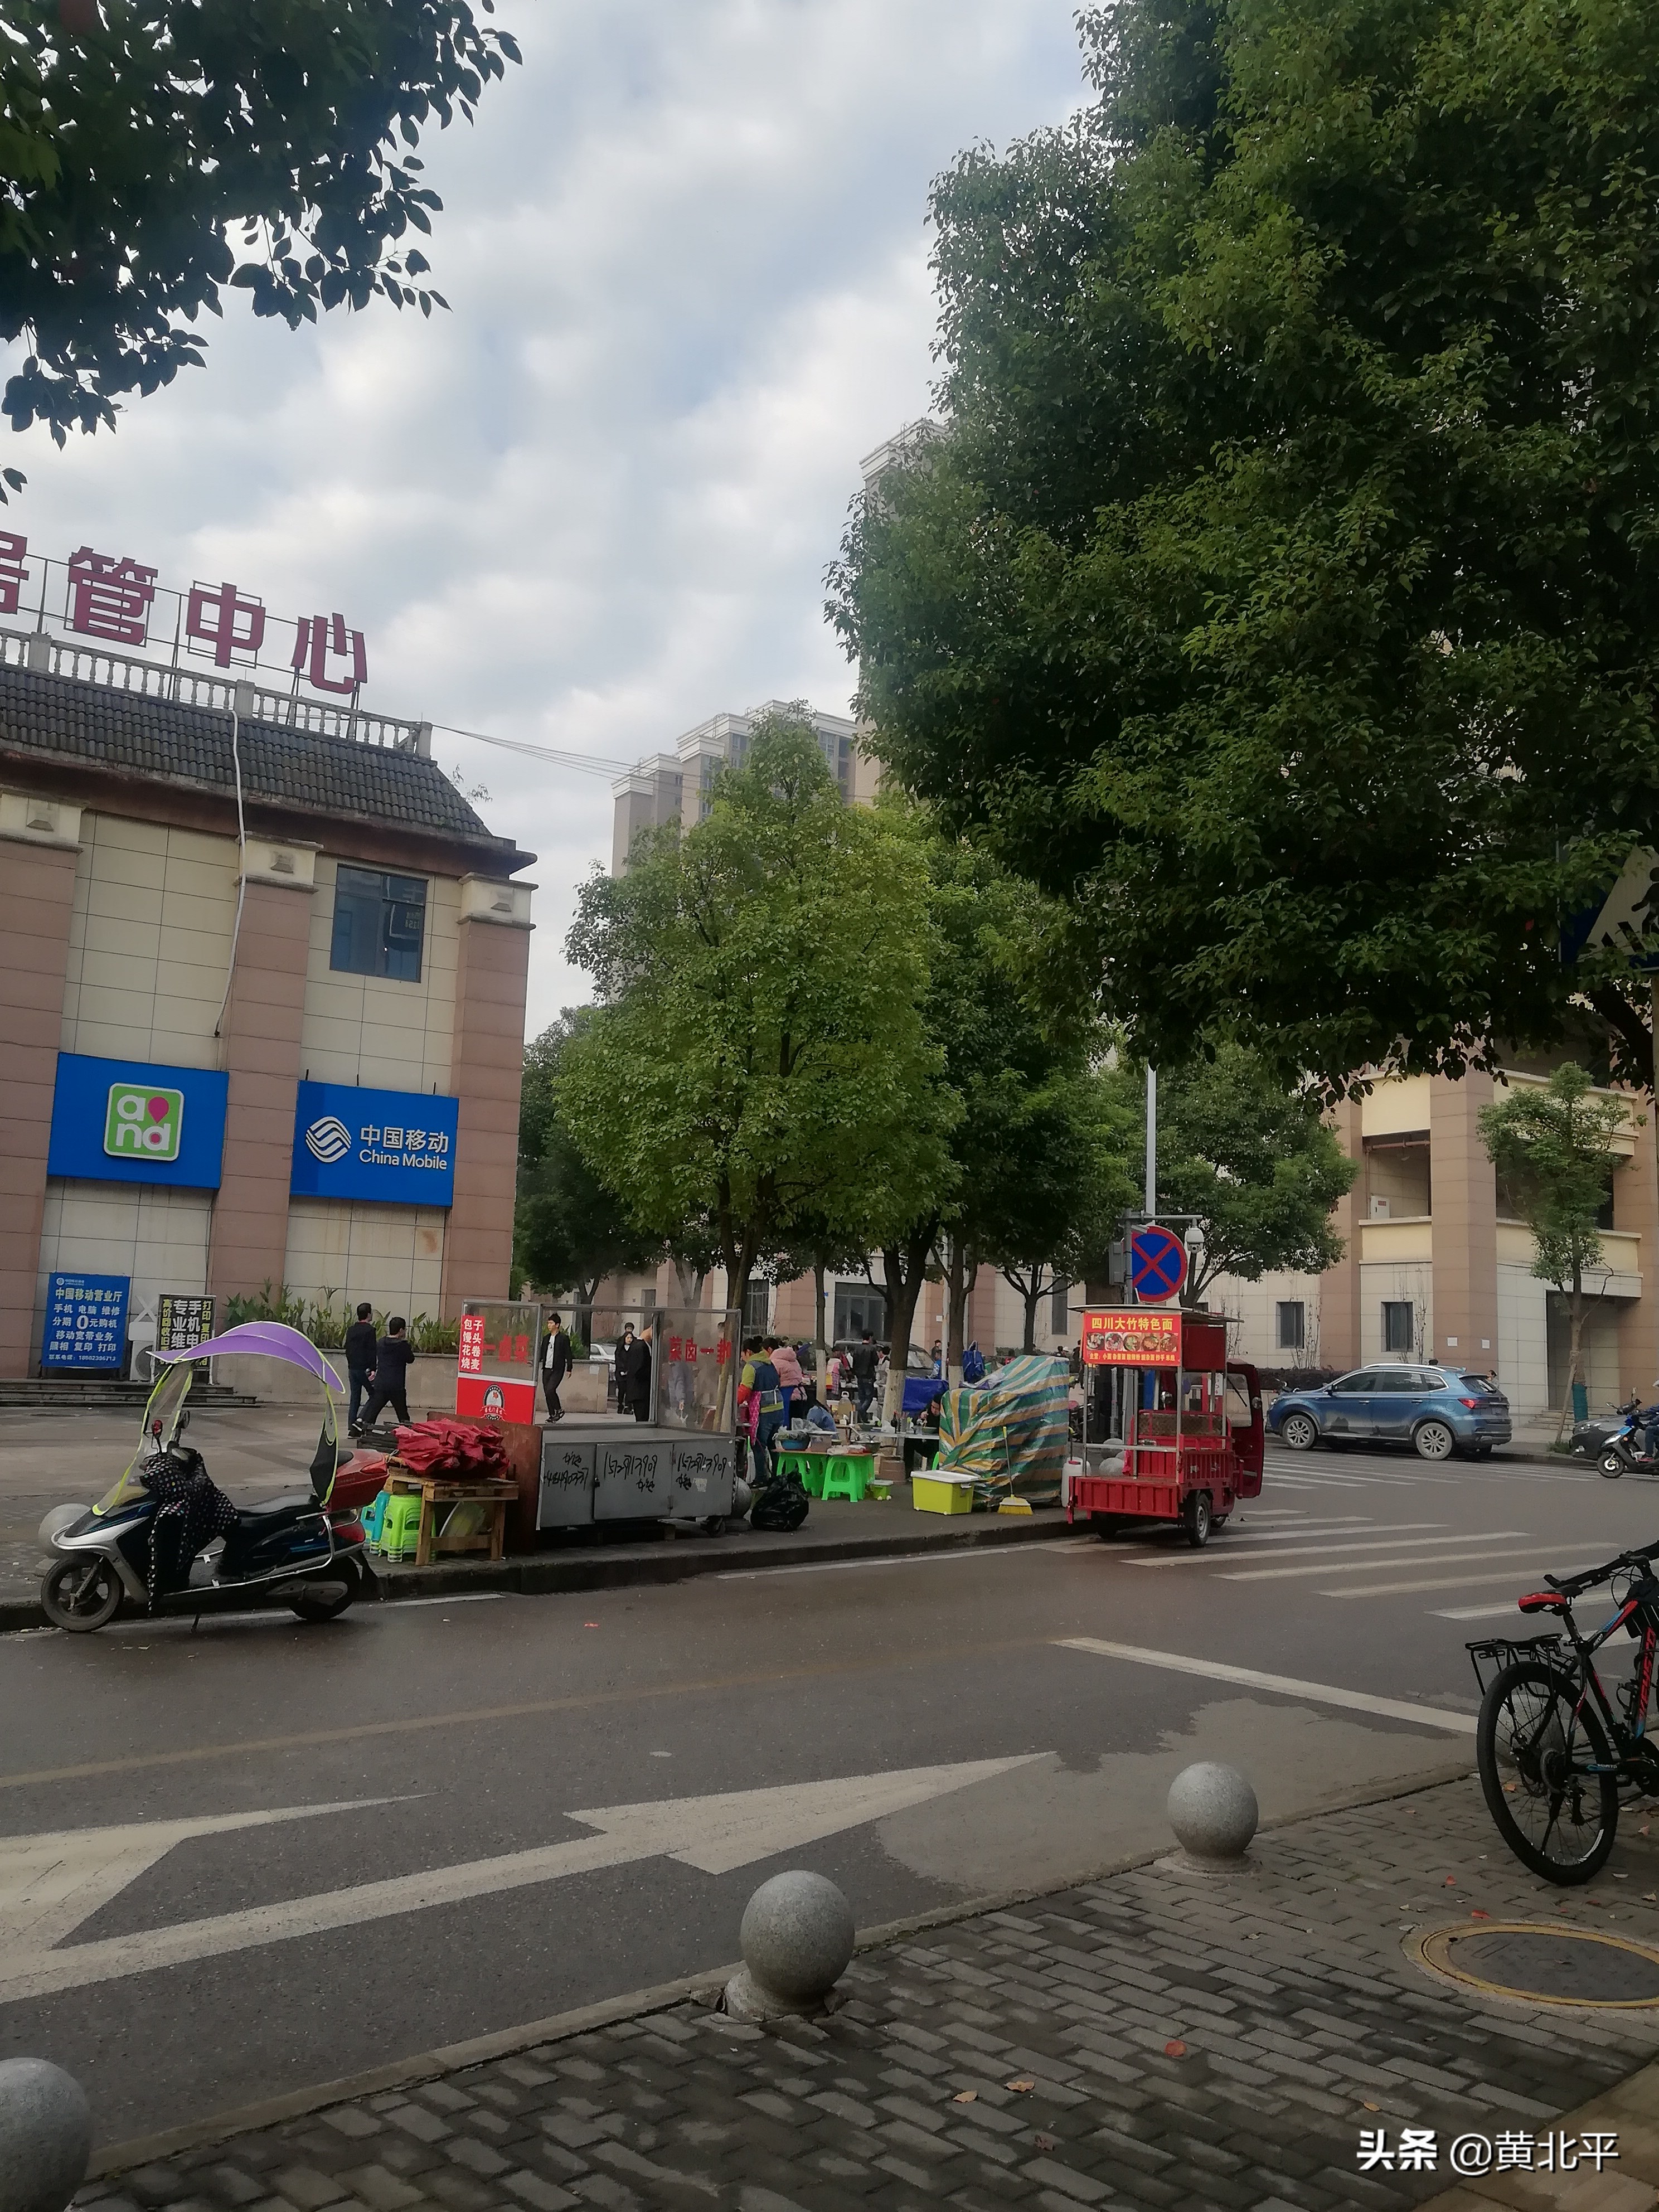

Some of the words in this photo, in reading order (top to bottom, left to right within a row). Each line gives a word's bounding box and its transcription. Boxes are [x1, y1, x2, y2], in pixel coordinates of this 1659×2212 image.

[360, 1124, 449, 1153] 中国移动
[359, 1149, 399, 1166] China
[402, 1153, 447, 1170] Mobile
[55, 1287, 123, 1303] 中国移动营业厅
[54, 1303, 73, 1313] 手机
[78, 1305, 97, 1314] 电脑
[101, 1306, 121, 1316] 维修
[52, 1316, 72, 1326] 分期
[464, 1319, 483, 1331] 包子
[1092, 1317, 1173, 1331] 四川大竹特色面
[56, 1330, 114, 1342] 移动宽带业务
[463, 1331, 481, 1344] 馒头
[49, 1341, 69, 1351] 照相
[74, 1342, 93, 1352] 复印
[98, 1342, 117, 1352] 打印
[462, 1345, 481, 1357] 花卷
[461, 1357, 480, 1370] 烧麦
